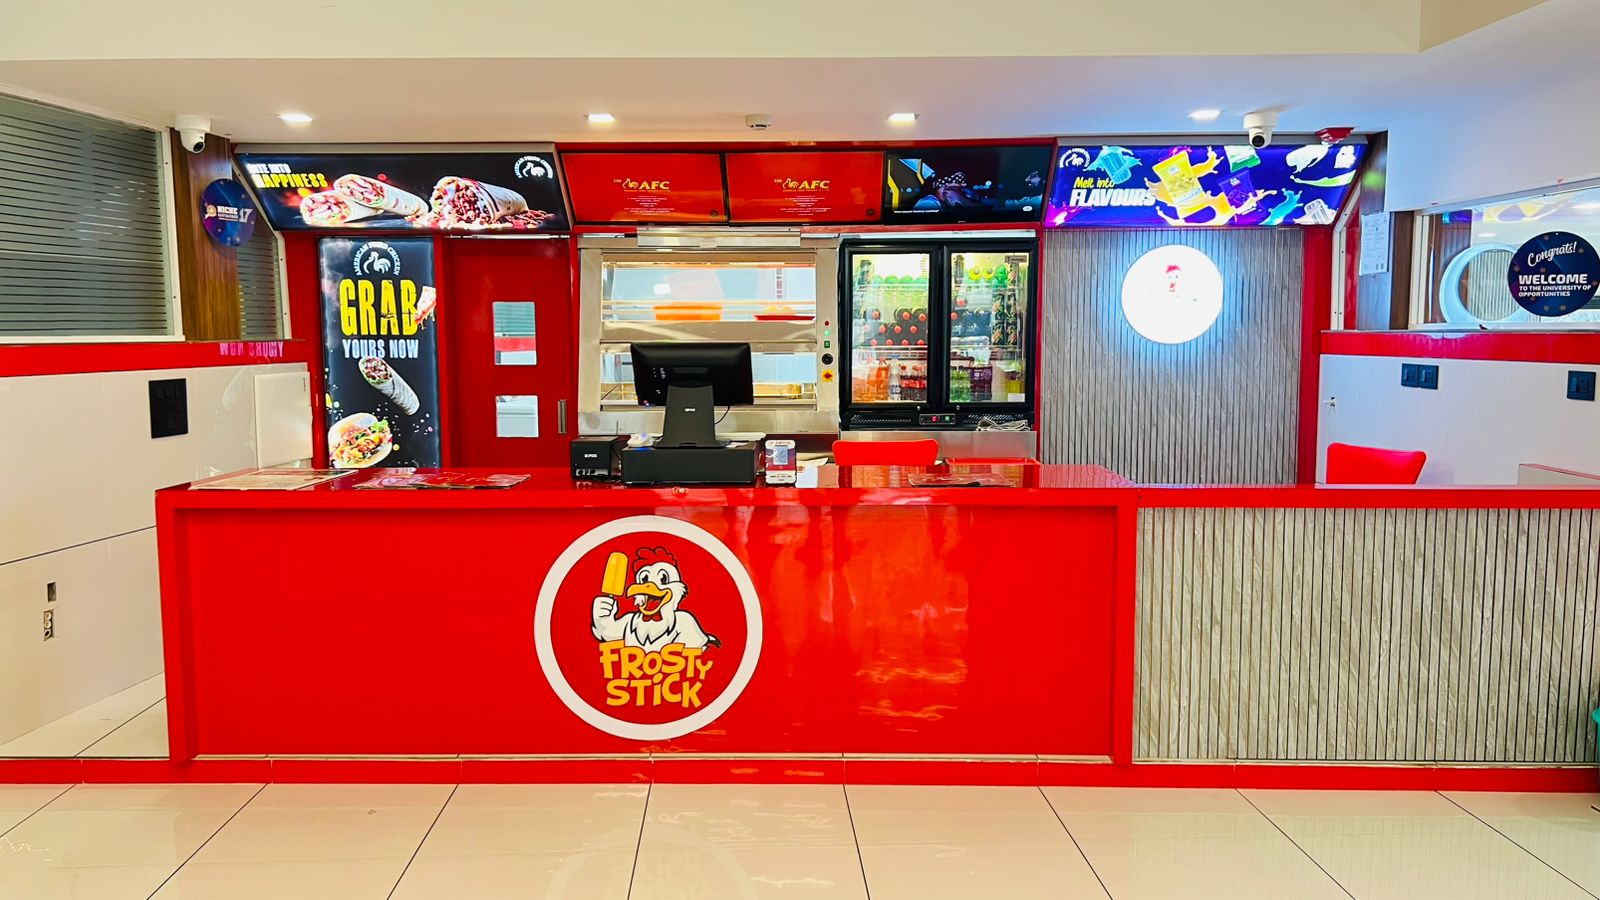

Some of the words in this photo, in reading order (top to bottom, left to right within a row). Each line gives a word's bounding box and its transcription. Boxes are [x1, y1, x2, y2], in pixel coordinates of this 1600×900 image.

[251, 173, 328, 188] APPINESS
[638, 180, 670, 190] AFC
[799, 180, 830, 189] AFC
[1096, 177, 1115, 188] into
[1069, 188, 1157, 207] FLAVOURS
[353, 243, 369, 276] AMERICAN
[1527, 241, 1577, 267] Congrats!
[1518, 273, 1588, 285] WELCOME
[339, 278, 418, 336] GRAB
[342, 339, 385, 358] YOURS
[389, 339, 419, 358] NOW
